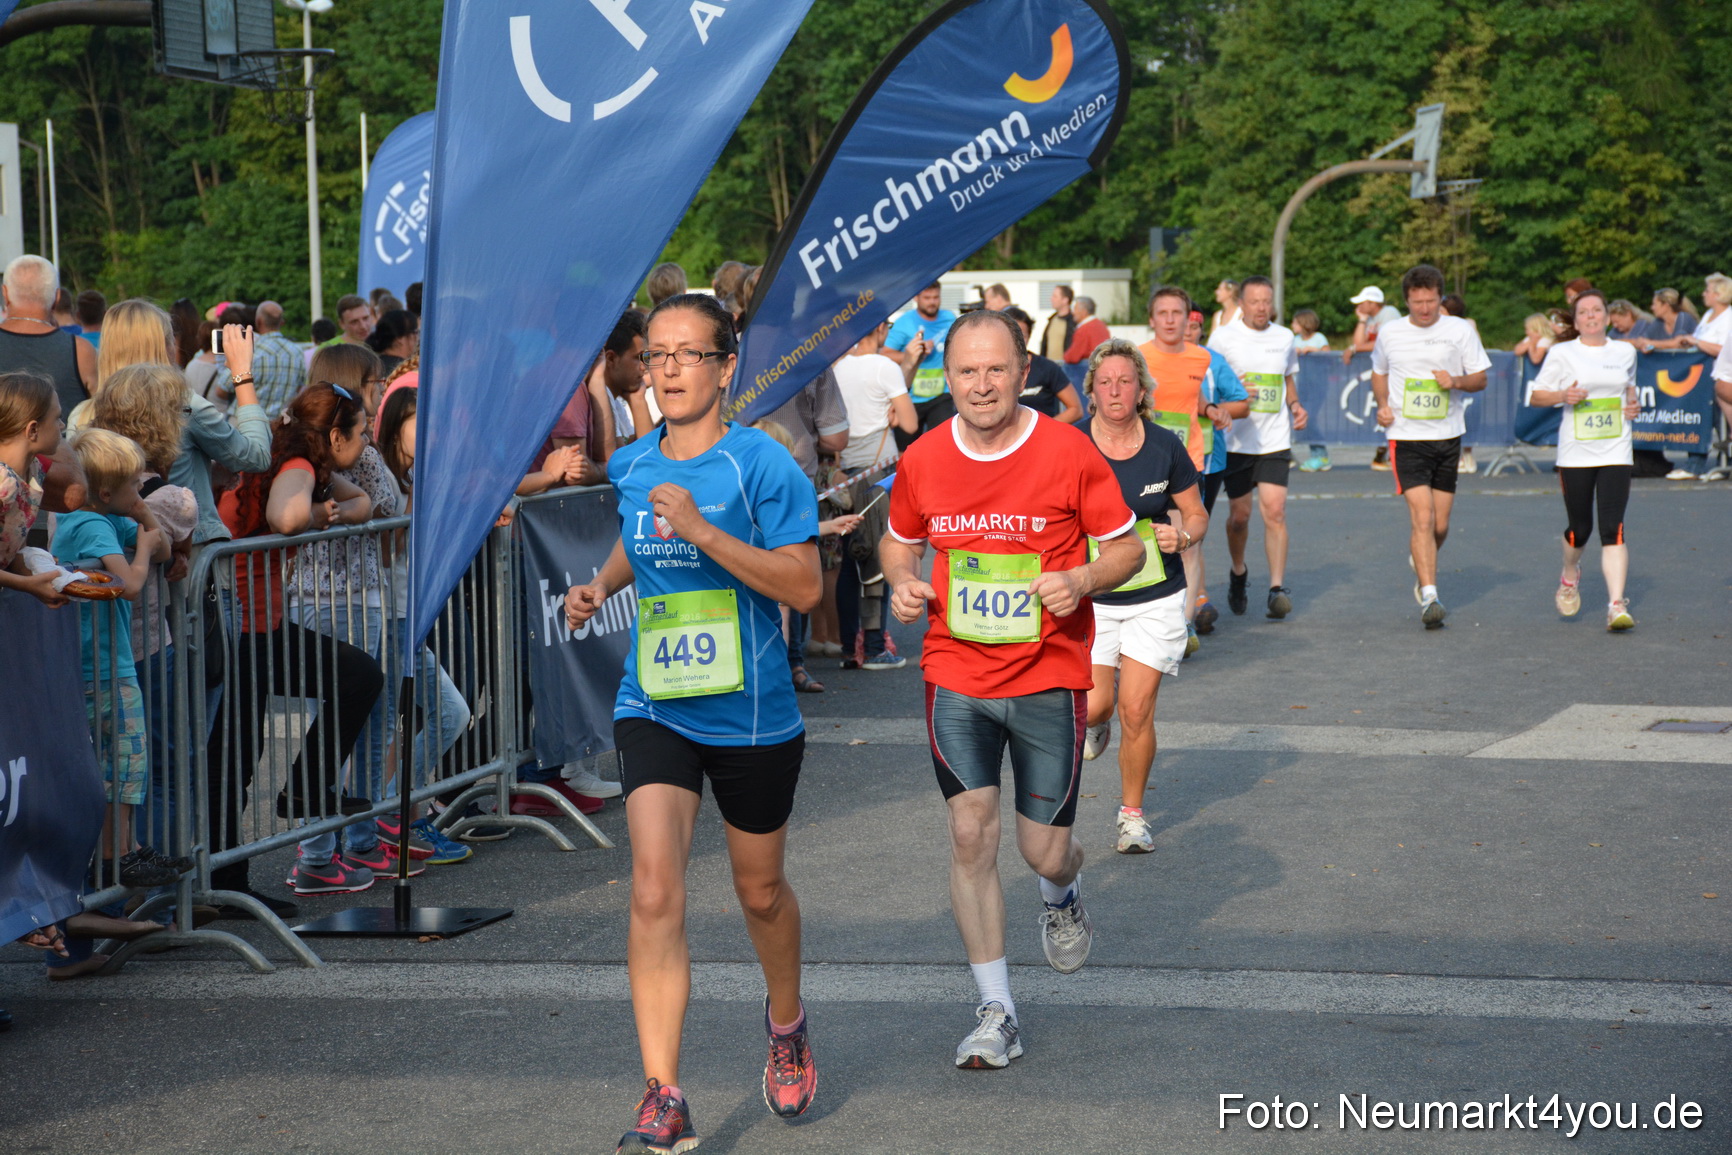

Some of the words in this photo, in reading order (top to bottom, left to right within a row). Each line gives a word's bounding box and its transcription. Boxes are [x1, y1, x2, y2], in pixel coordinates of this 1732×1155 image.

[948, 165, 1005, 213] Druck
[1006, 142, 1044, 173] und
[1041, 93, 1107, 151] Medien
[799, 110, 1031, 290] Frischmann
[1413, 395, 1440, 408] 430
[1584, 414, 1613, 429] 434
[1656, 409, 1701, 424] Medien
[633, 511, 648, 539] I
[931, 513, 1027, 533] NEUMARKT
[634, 539, 698, 560] camping
[957, 586, 1032, 619] 1402
[974, 622, 993, 631] Werner
[653, 632, 717, 669] 449
